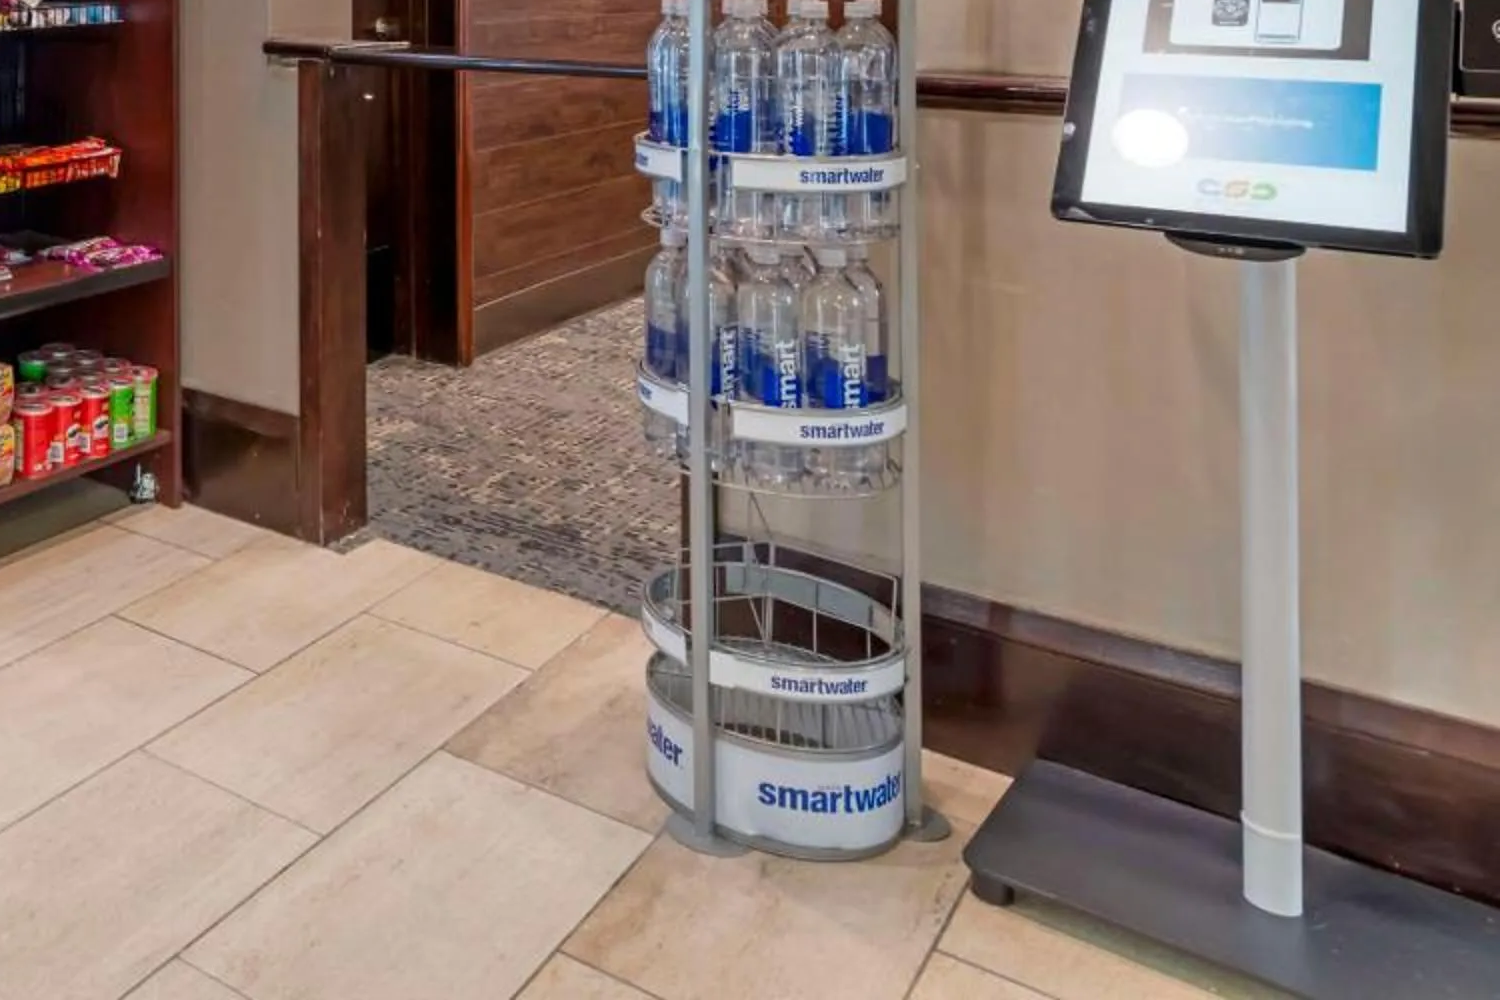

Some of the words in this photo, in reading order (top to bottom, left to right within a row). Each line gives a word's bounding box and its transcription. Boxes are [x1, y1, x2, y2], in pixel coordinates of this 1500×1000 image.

[799, 167, 885, 185] smartwater
[799, 418, 885, 440] smartwater
[770, 674, 868, 695] smartwater
